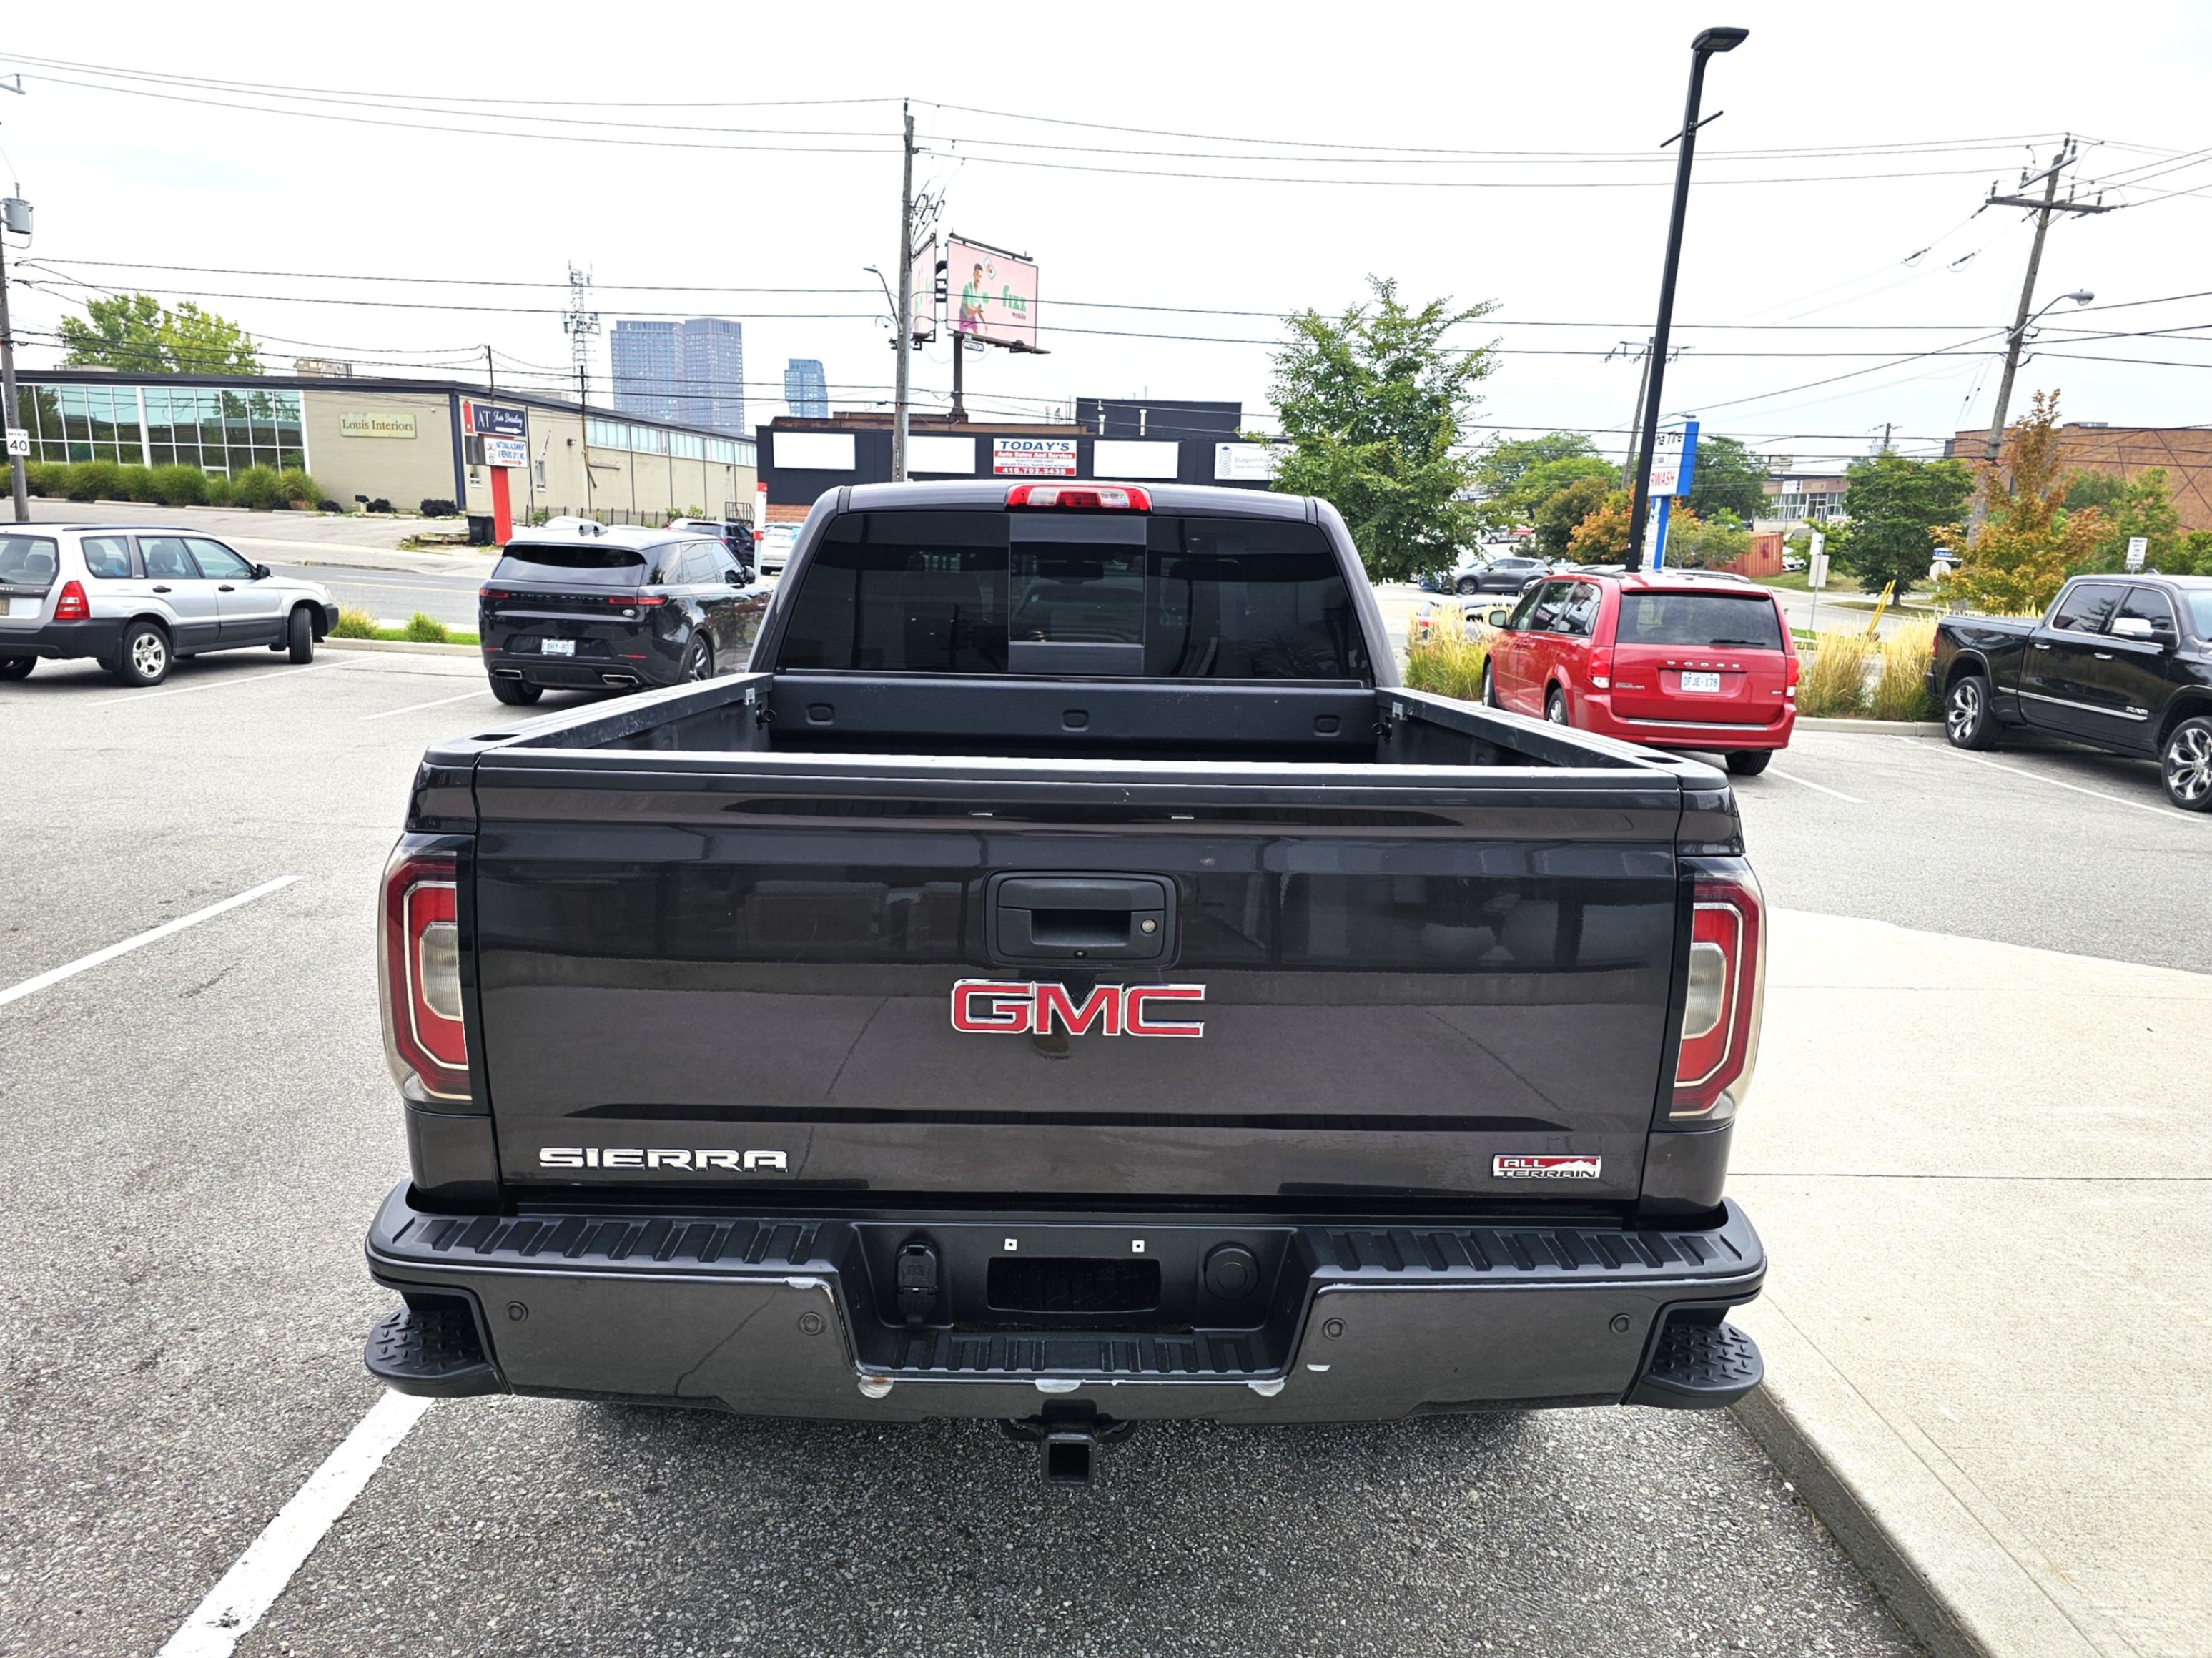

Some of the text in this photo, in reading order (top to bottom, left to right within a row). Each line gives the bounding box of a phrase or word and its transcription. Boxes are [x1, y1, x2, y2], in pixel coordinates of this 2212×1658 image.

[1002, 285, 1027, 312] fizz
[342, 418, 414, 431] Louis Interiors
[478, 410, 491, 428] AT
[9, 440, 27, 451] 40
[1000, 440, 1070, 451] TODAY'S
[1650, 470, 1675, 487] RWASH
[951, 979, 1206, 1037] GMC
[540, 1147, 788, 1173] SIERRA
[1504, 1158, 1546, 1168] ALL
[1498, 1170, 1596, 1178] TERRAIN
